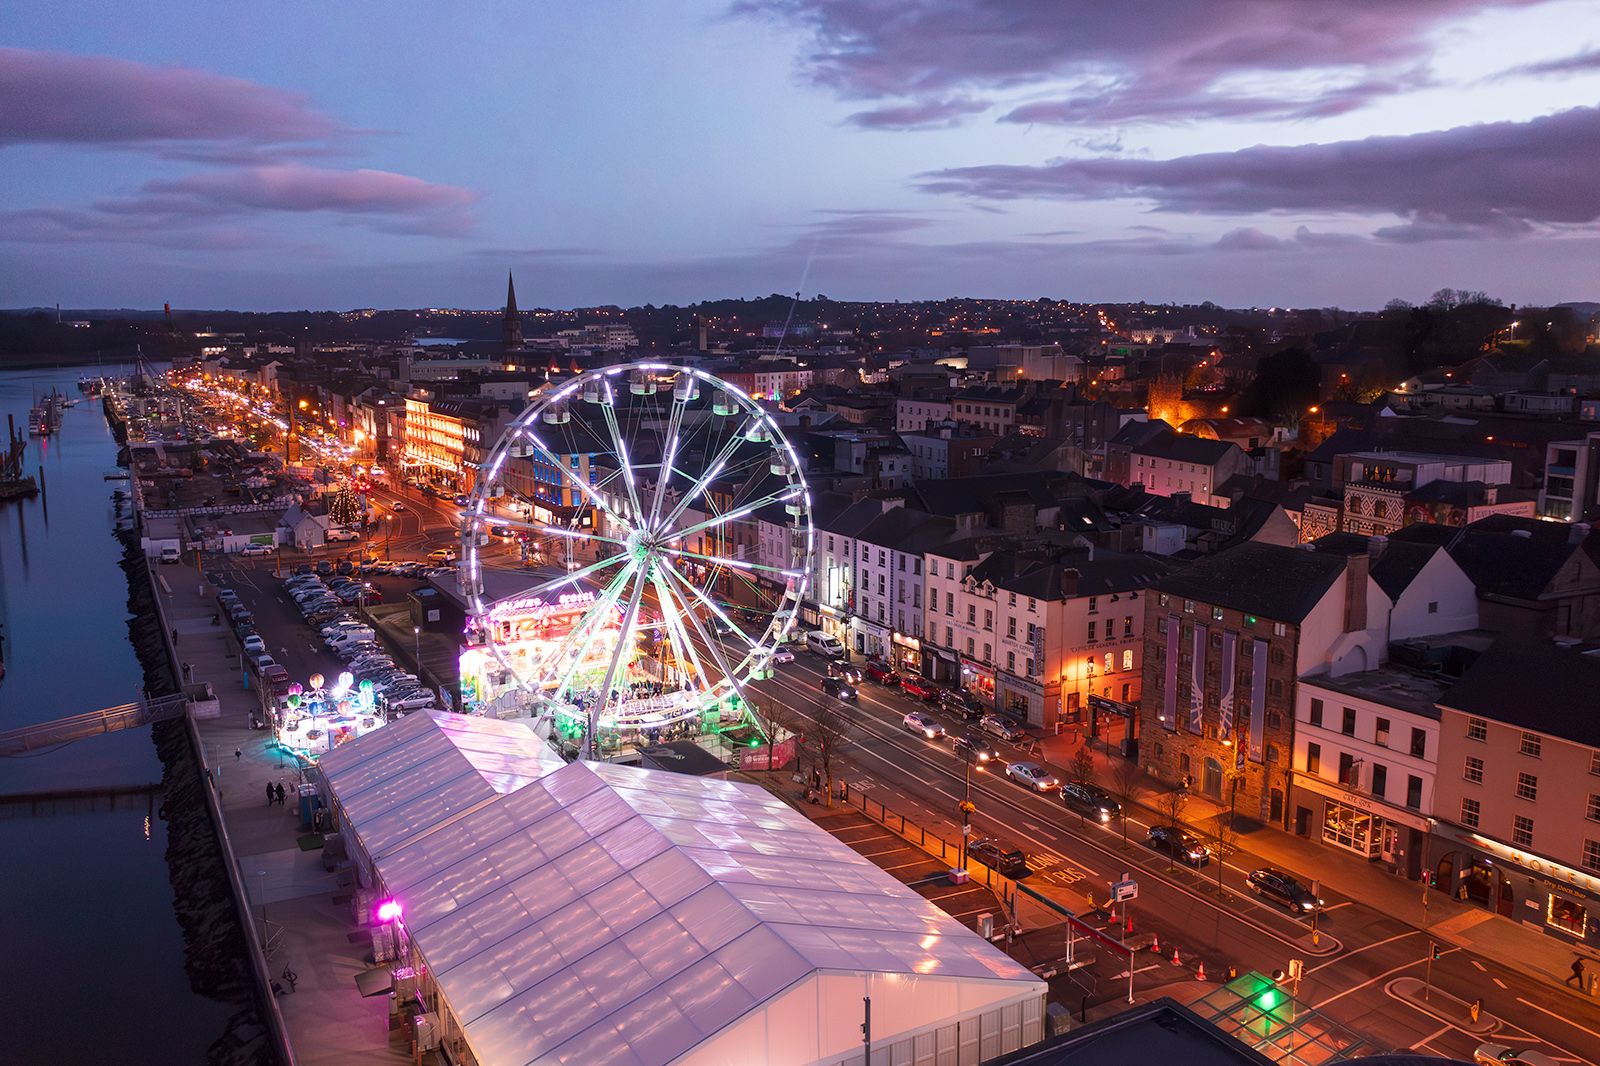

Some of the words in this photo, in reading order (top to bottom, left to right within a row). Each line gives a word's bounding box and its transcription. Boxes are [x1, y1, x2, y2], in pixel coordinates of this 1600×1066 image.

[848, 779, 876, 792] BUS
[1052, 867, 1087, 884] BUS
[1511, 851, 1595, 891] HOTEL
